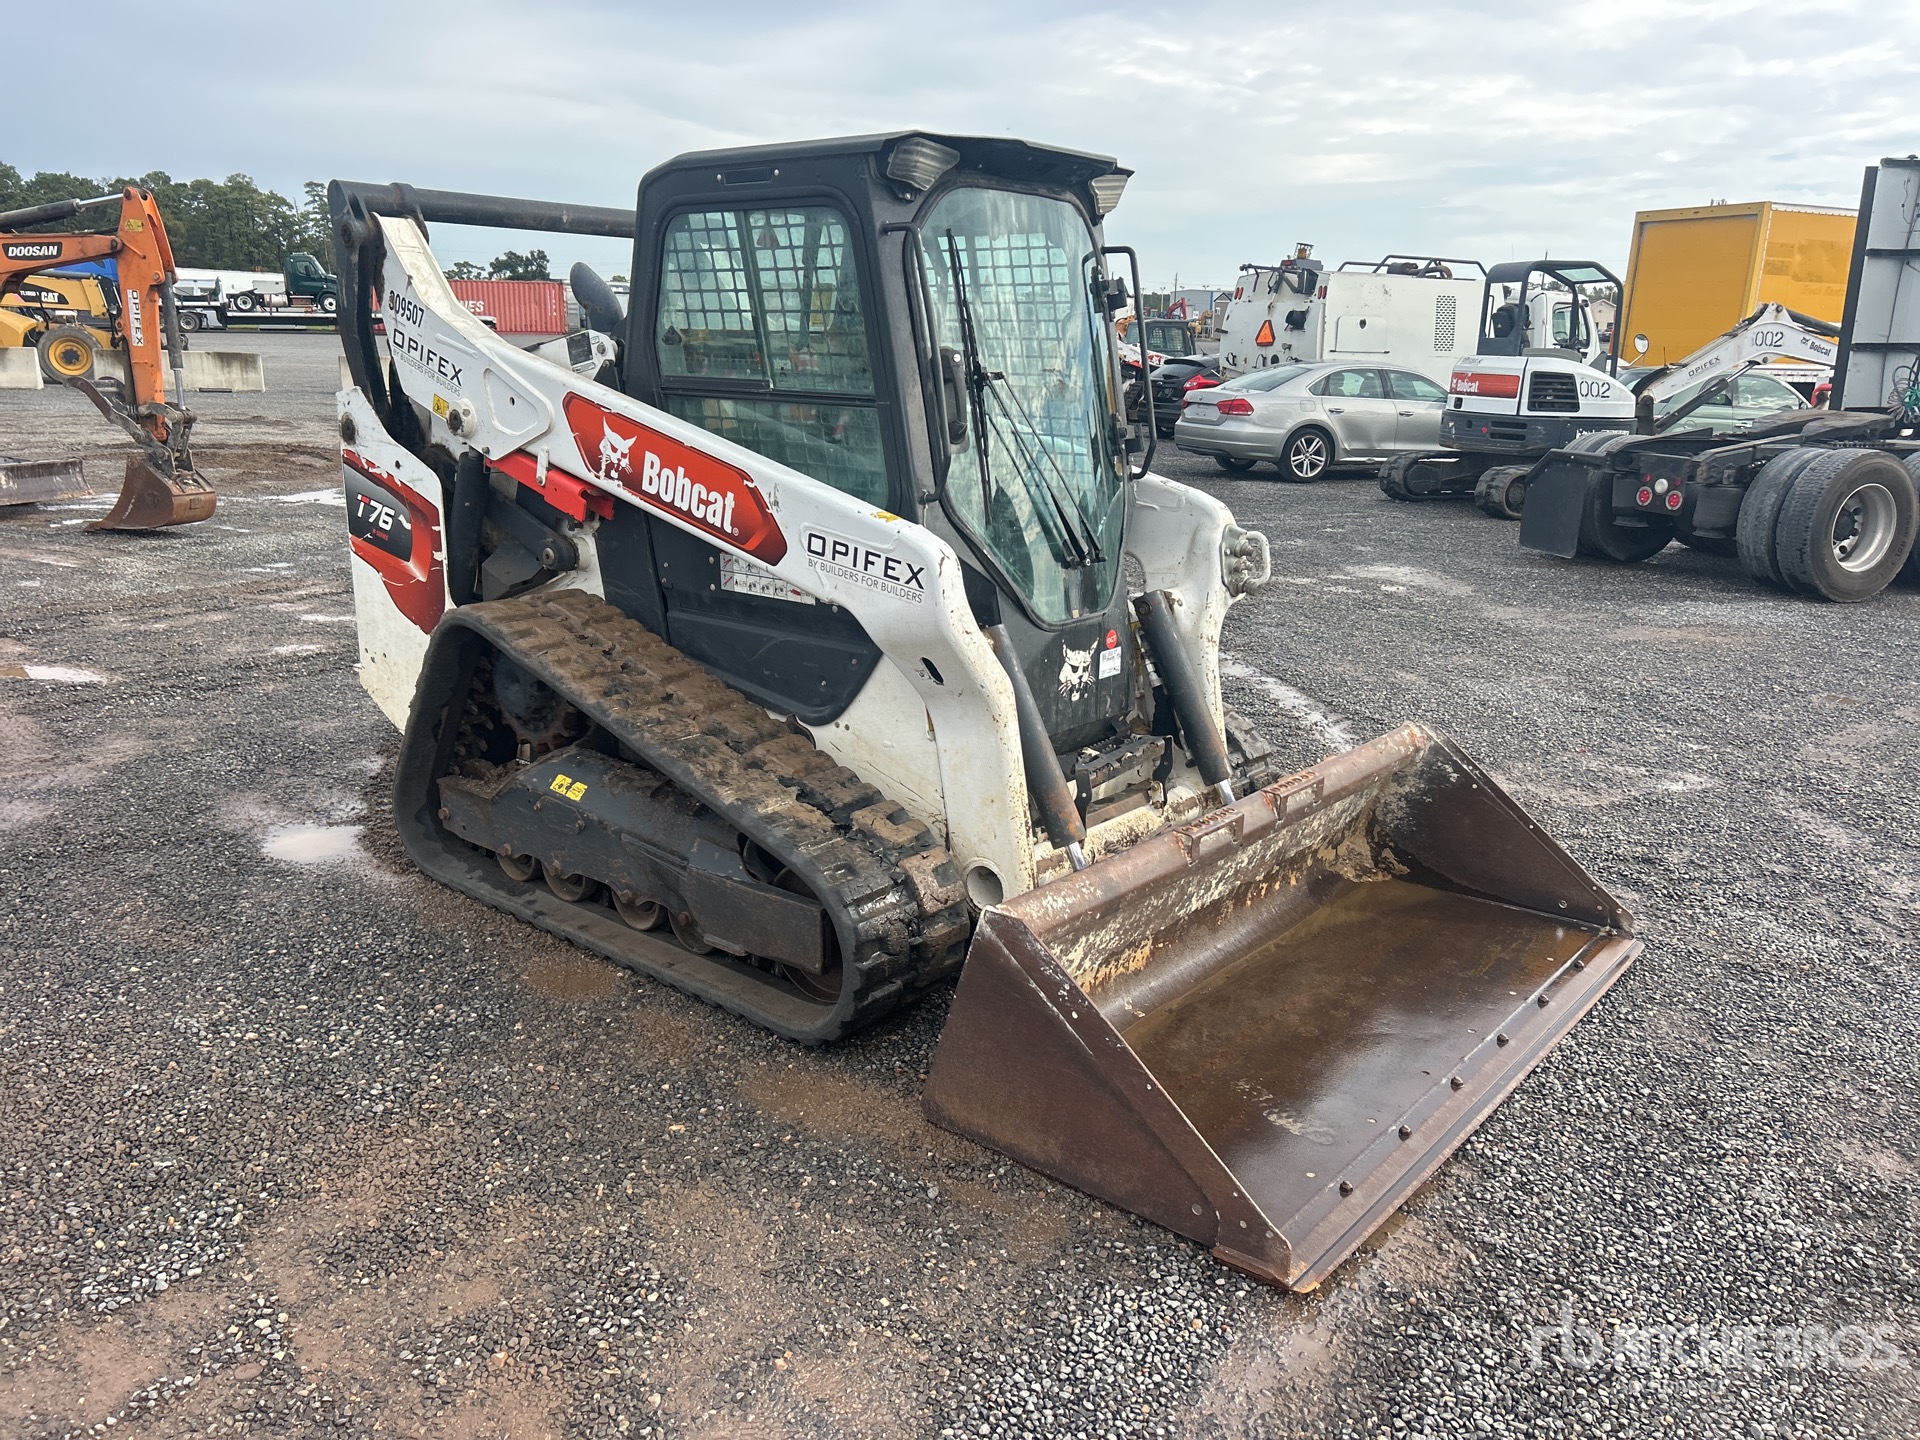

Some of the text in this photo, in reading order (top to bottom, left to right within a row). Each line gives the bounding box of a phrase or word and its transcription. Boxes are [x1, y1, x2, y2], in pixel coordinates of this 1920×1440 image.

[8, 245, 58, 257] DOOSAN
[41, 291, 59, 303] CAT
[388, 289, 425, 328] 309507
[131, 290, 143, 345] OPIFEX
[393, 328, 463, 387] OPIFEX
[1688, 355, 1721, 377] OPIFEX
[1809, 341, 1832, 357] Bobcat
[393, 348, 461, 397] BY BUILDERS FOR BUILDERS
[1456, 378, 1479, 393] Bobcat
[1579, 380, 1611, 398] 002
[642, 450, 735, 534] Bobcat
[357, 493, 396, 531] T76
[807, 532, 925, 590] OPIFEX
[808, 558, 923, 604] BY BUILDERS FOR BUILDERS
